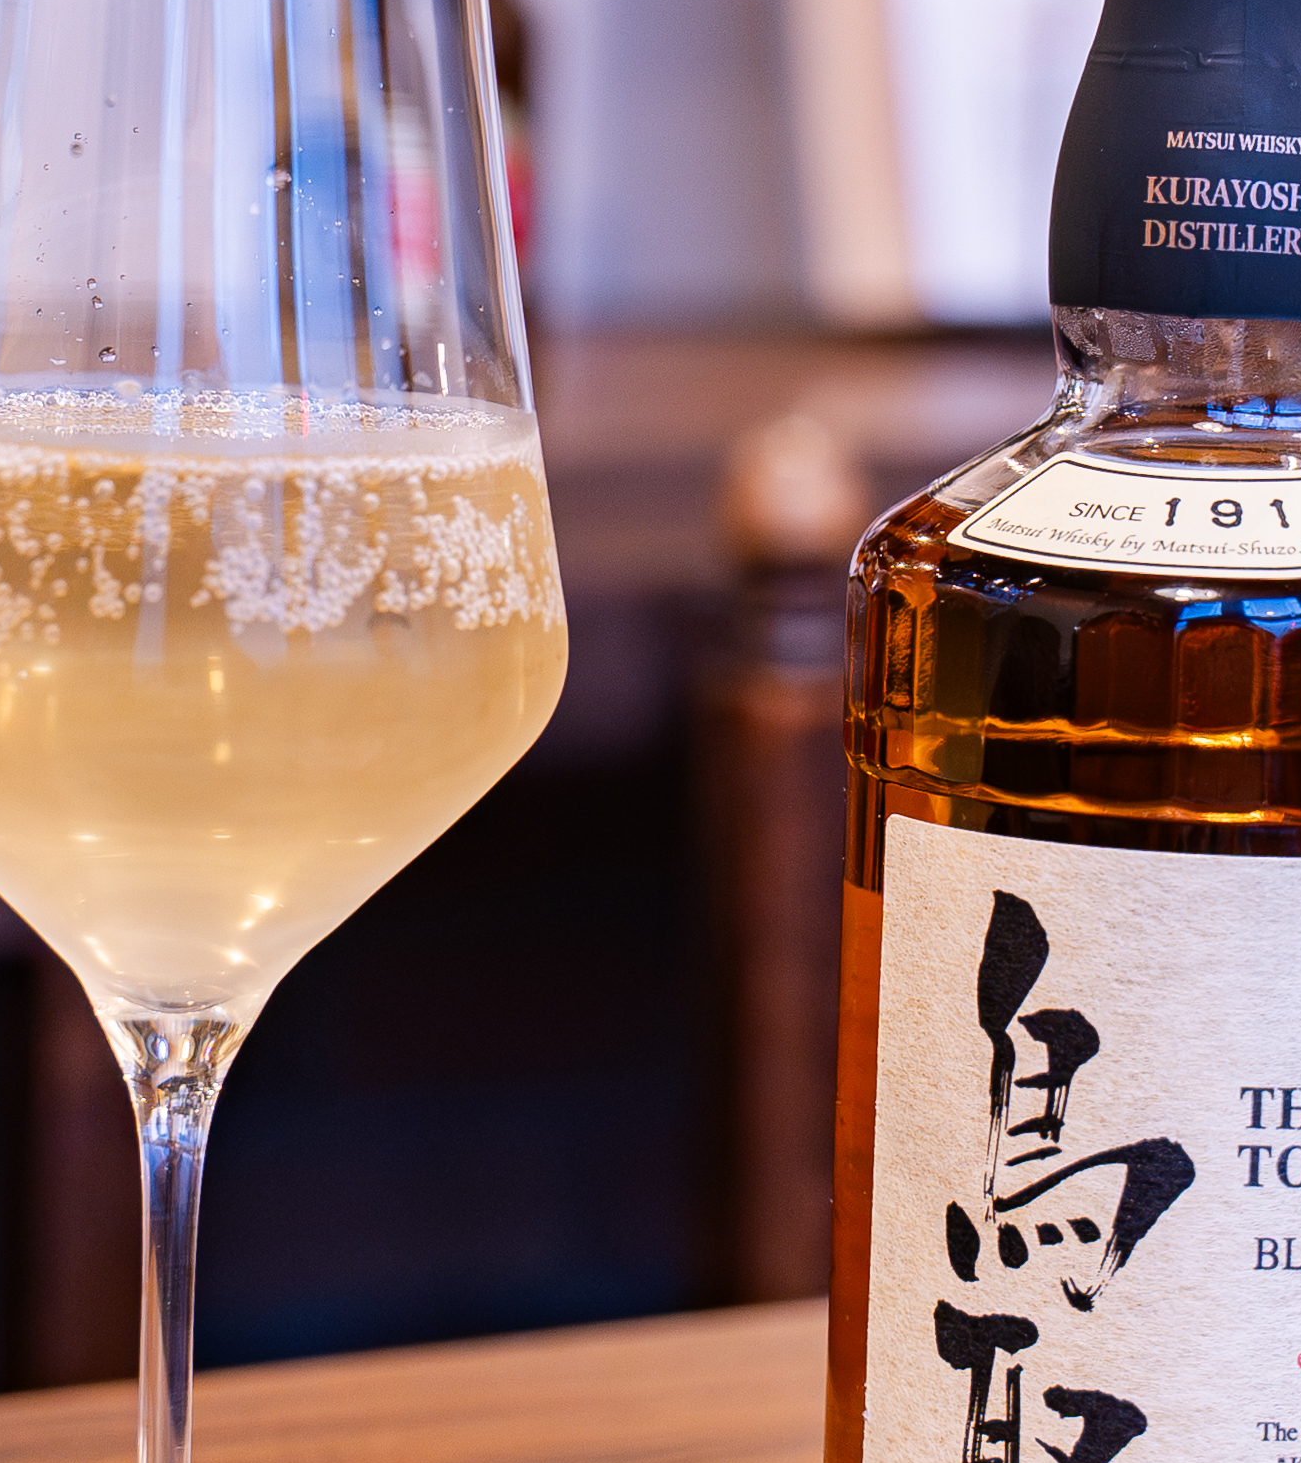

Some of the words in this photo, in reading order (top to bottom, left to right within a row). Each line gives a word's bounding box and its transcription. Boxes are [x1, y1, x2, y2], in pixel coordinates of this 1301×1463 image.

[1166, 130, 1235, 151] MATSUI
[1068, 501, 1146, 522] SINCE
[986, 517, 1047, 539] Matsui
[1049, 528, 1116, 553] Whisky
[1120, 534, 1146, 556] by
[1256, 1421, 1298, 1442] The
